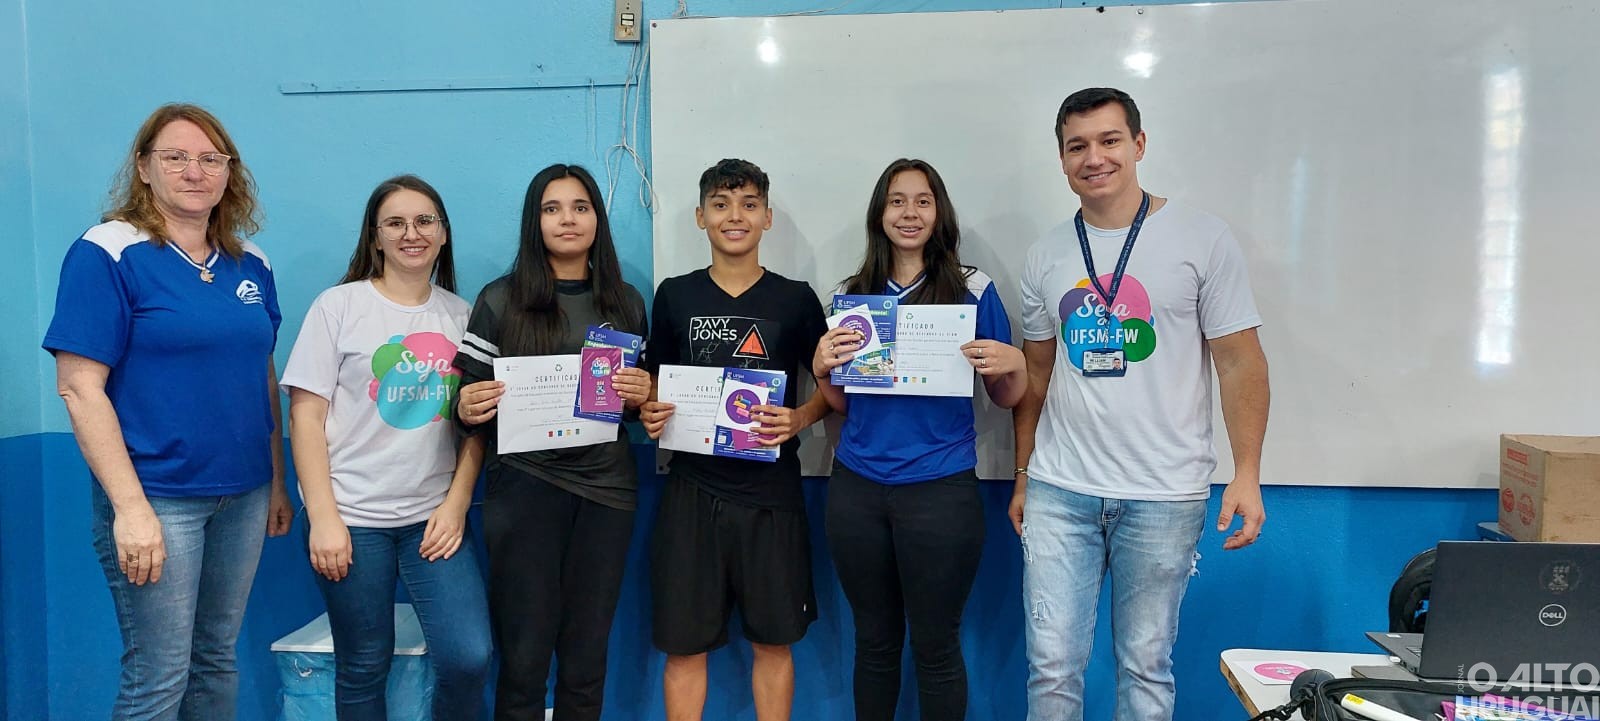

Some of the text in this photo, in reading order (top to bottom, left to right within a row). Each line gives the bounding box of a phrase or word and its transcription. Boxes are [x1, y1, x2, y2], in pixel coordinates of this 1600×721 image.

[693, 318, 730, 329] DAVY
[692, 328, 738, 341] JONES
[1070, 328, 1139, 345] UFSM-FW
[395, 350, 452, 383] Seja
